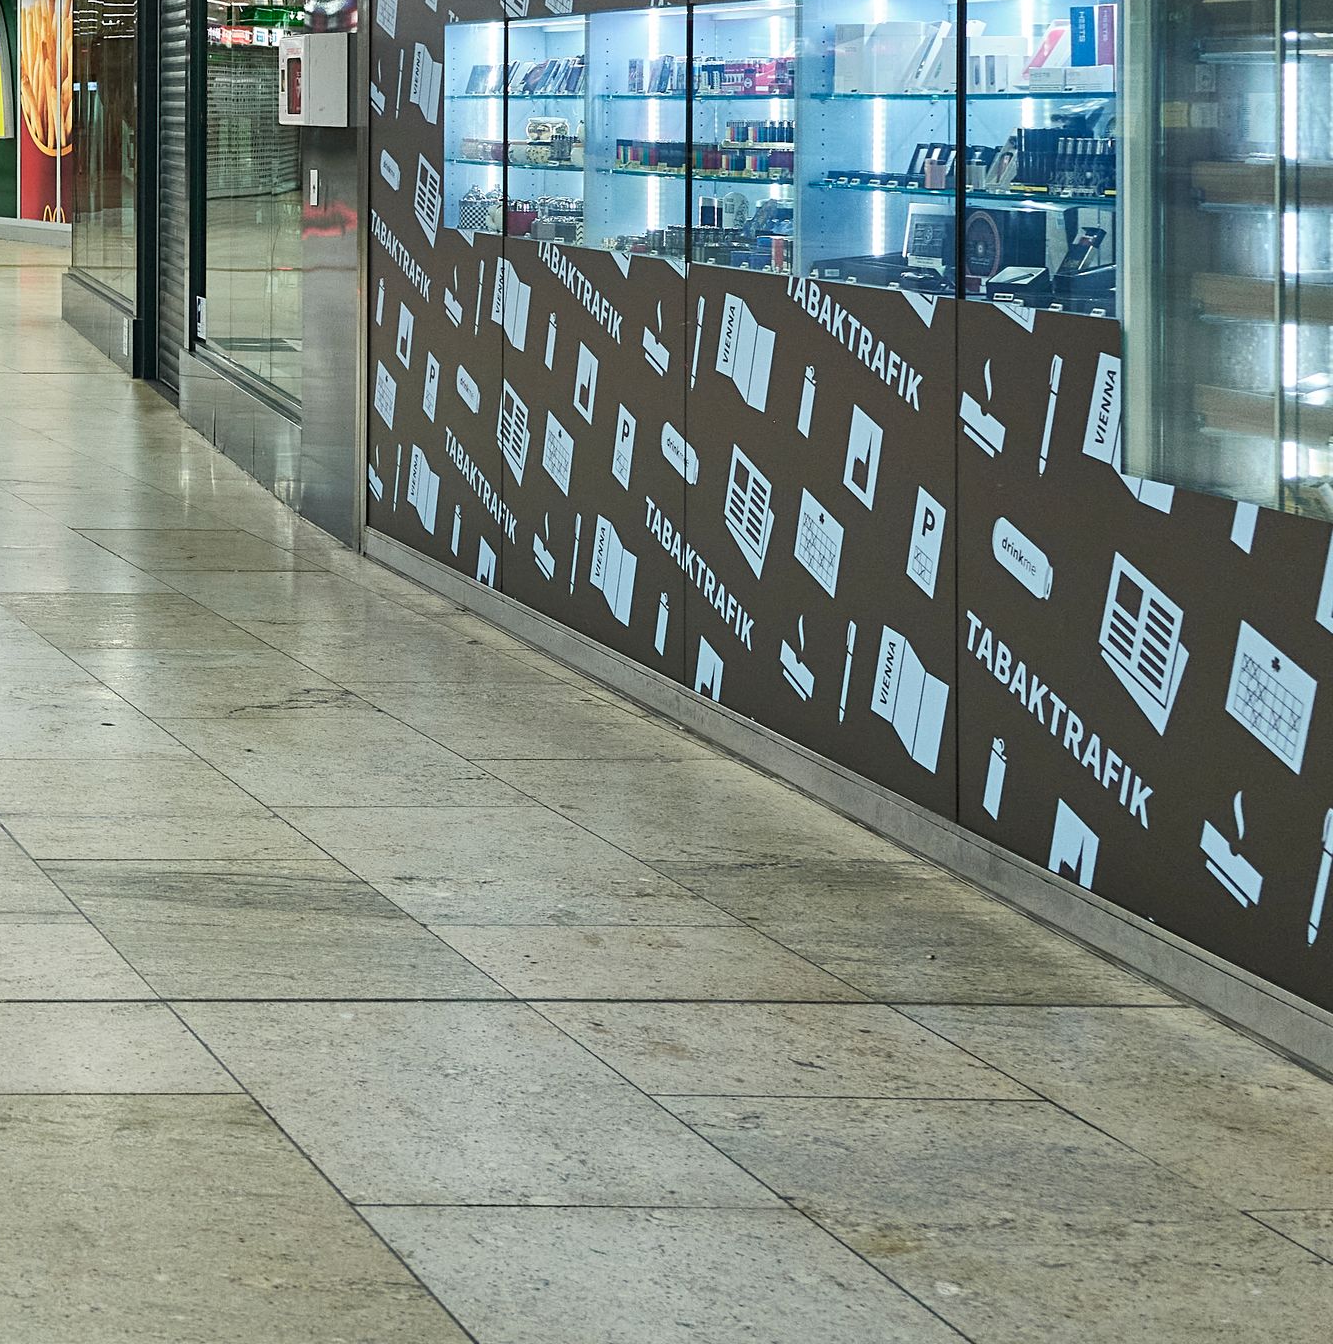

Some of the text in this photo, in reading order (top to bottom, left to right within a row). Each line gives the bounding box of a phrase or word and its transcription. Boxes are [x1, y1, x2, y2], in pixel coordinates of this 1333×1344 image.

[371, 208, 432, 304] TABAKTRAFIK
[537, 241, 623, 344] TABAKTRAFIK
[721, 304, 737, 364] VIENNA
[786, 275, 925, 412] TABAKTRAFIK
[1093, 368, 1118, 445] VIENNA
[445, 426, 517, 545] TABAKTRAFIK
[595, 525, 607, 578] VIENNA
[645, 496, 755, 652] TABAKTRAFIK
[1001, 537, 1038, 576] drinkme
[879, 640, 897, 706] VIENNA
[965, 609, 1154, 830] TABAKTRAFIK
